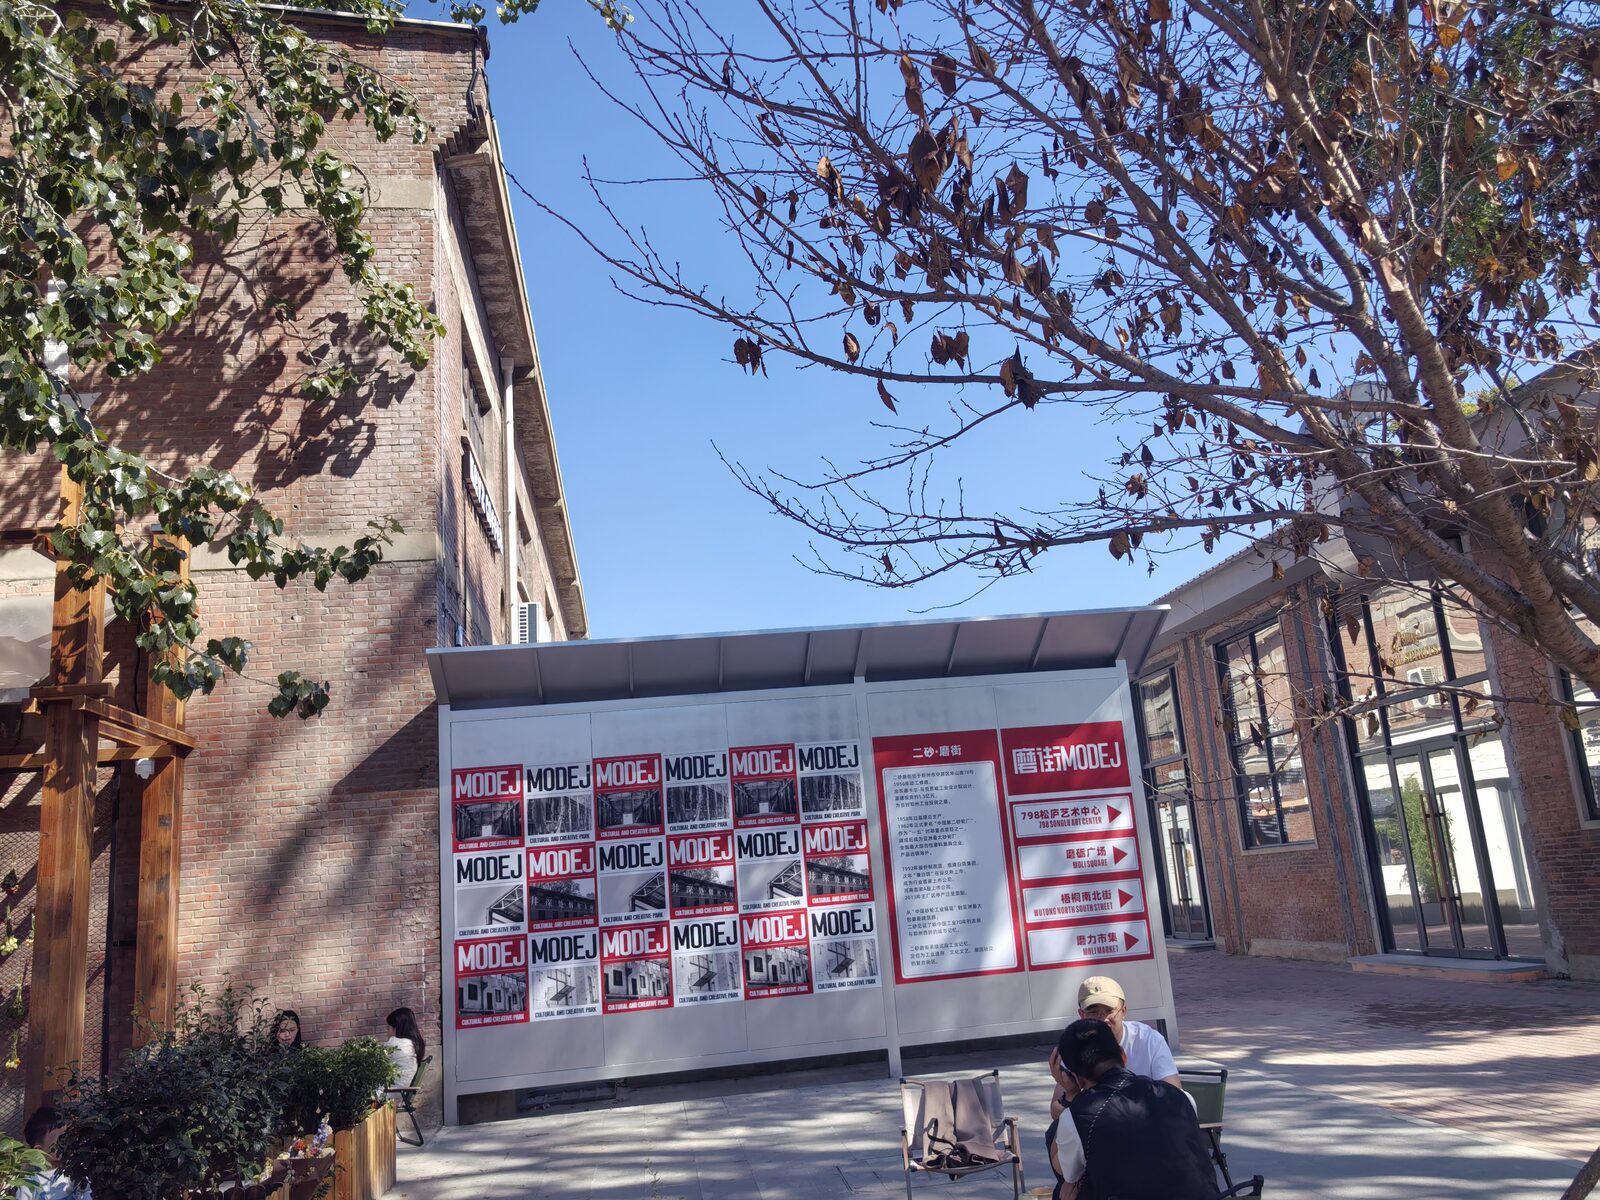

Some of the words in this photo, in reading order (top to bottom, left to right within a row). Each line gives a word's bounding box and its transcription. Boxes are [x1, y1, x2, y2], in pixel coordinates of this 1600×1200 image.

[732, 749, 793, 776] MODEJ
[798, 744, 858, 771] MODEJ
[912, 744, 962, 758] 二砂·磨街
[526, 764, 590, 792] MODEJ
[596, 759, 659, 786] MODEJ
[665, 754, 727, 781] MODEJ
[455, 770, 520, 798] MODEJ
[1020, 805, 1100, 820] 798松庐艺术中心
[669, 835, 732, 864] MODEJ
[737, 830, 799, 858] MODEJ
[804, 824, 866, 852] MODEJ
[1065, 846, 1106, 858] 磨砺广场
[457, 854, 522, 883] MODEJ
[529, 848, 593, 876] MODEJ
[599, 842, 663, 870] MODEJ
[1060, 889, 1111, 903] 梧桐南北街
[673, 920, 737, 950] MODEJ
[743, 914, 806, 944] MODEJ
[811, 908, 873, 937] MODEJ
[531, 933, 597, 963] MODEJ
[602, 927, 668, 957] MODEJ
[1076, 932, 1117, 945] 磨力市集
[458, 940, 524, 971] MODEJ
